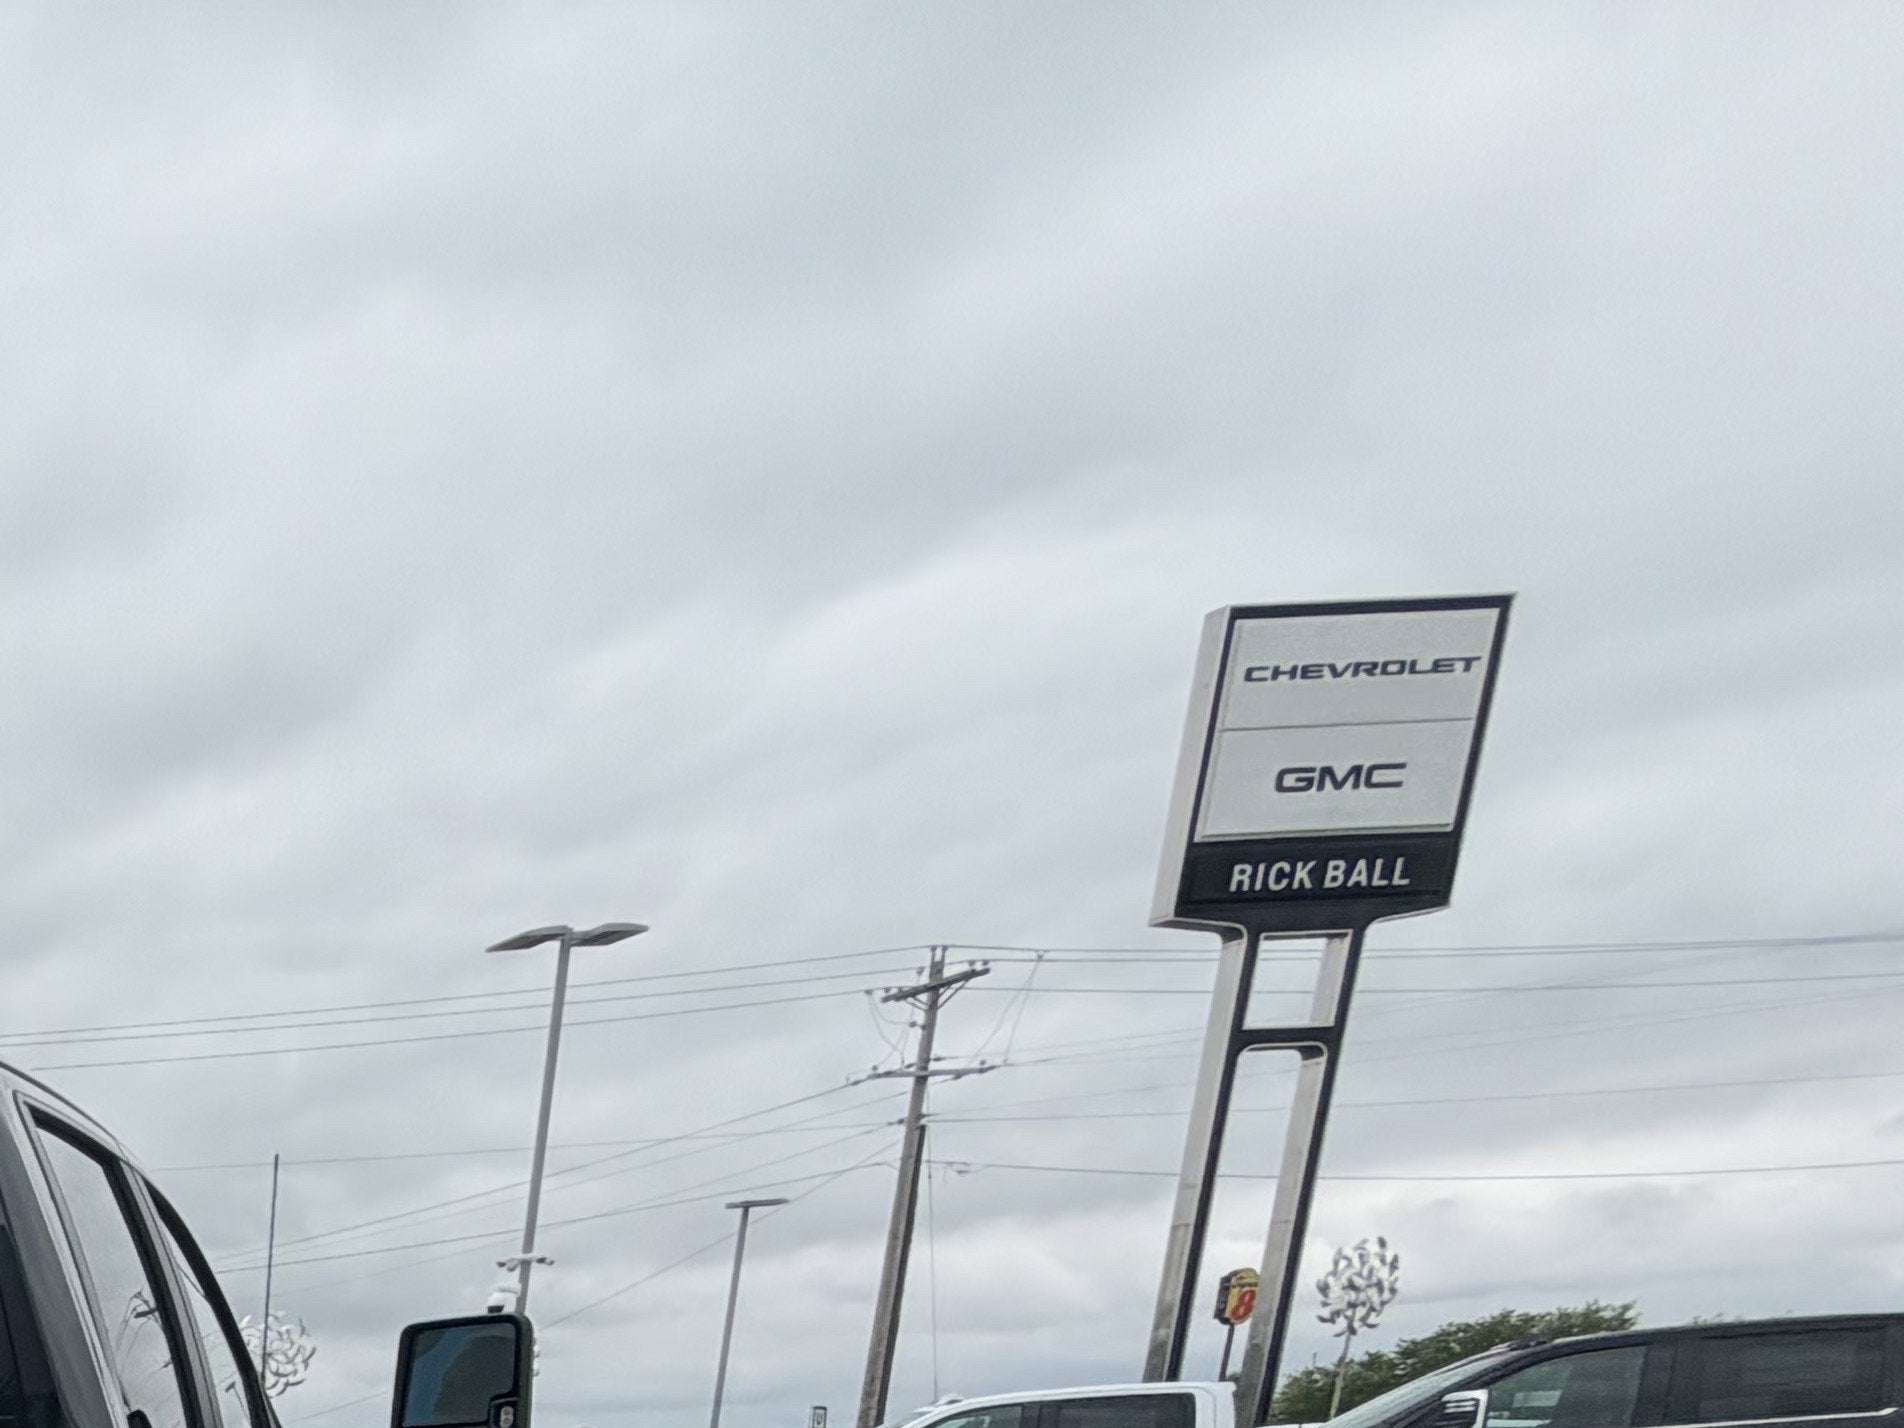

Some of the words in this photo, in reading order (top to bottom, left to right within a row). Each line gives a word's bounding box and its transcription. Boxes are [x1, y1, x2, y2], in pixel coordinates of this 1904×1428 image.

[1243, 656, 1482, 682] CHEVROLET
[1274, 762, 1408, 793] GMC
[1229, 860, 1317, 892] RICK
[1323, 856, 1411, 888] BALL
